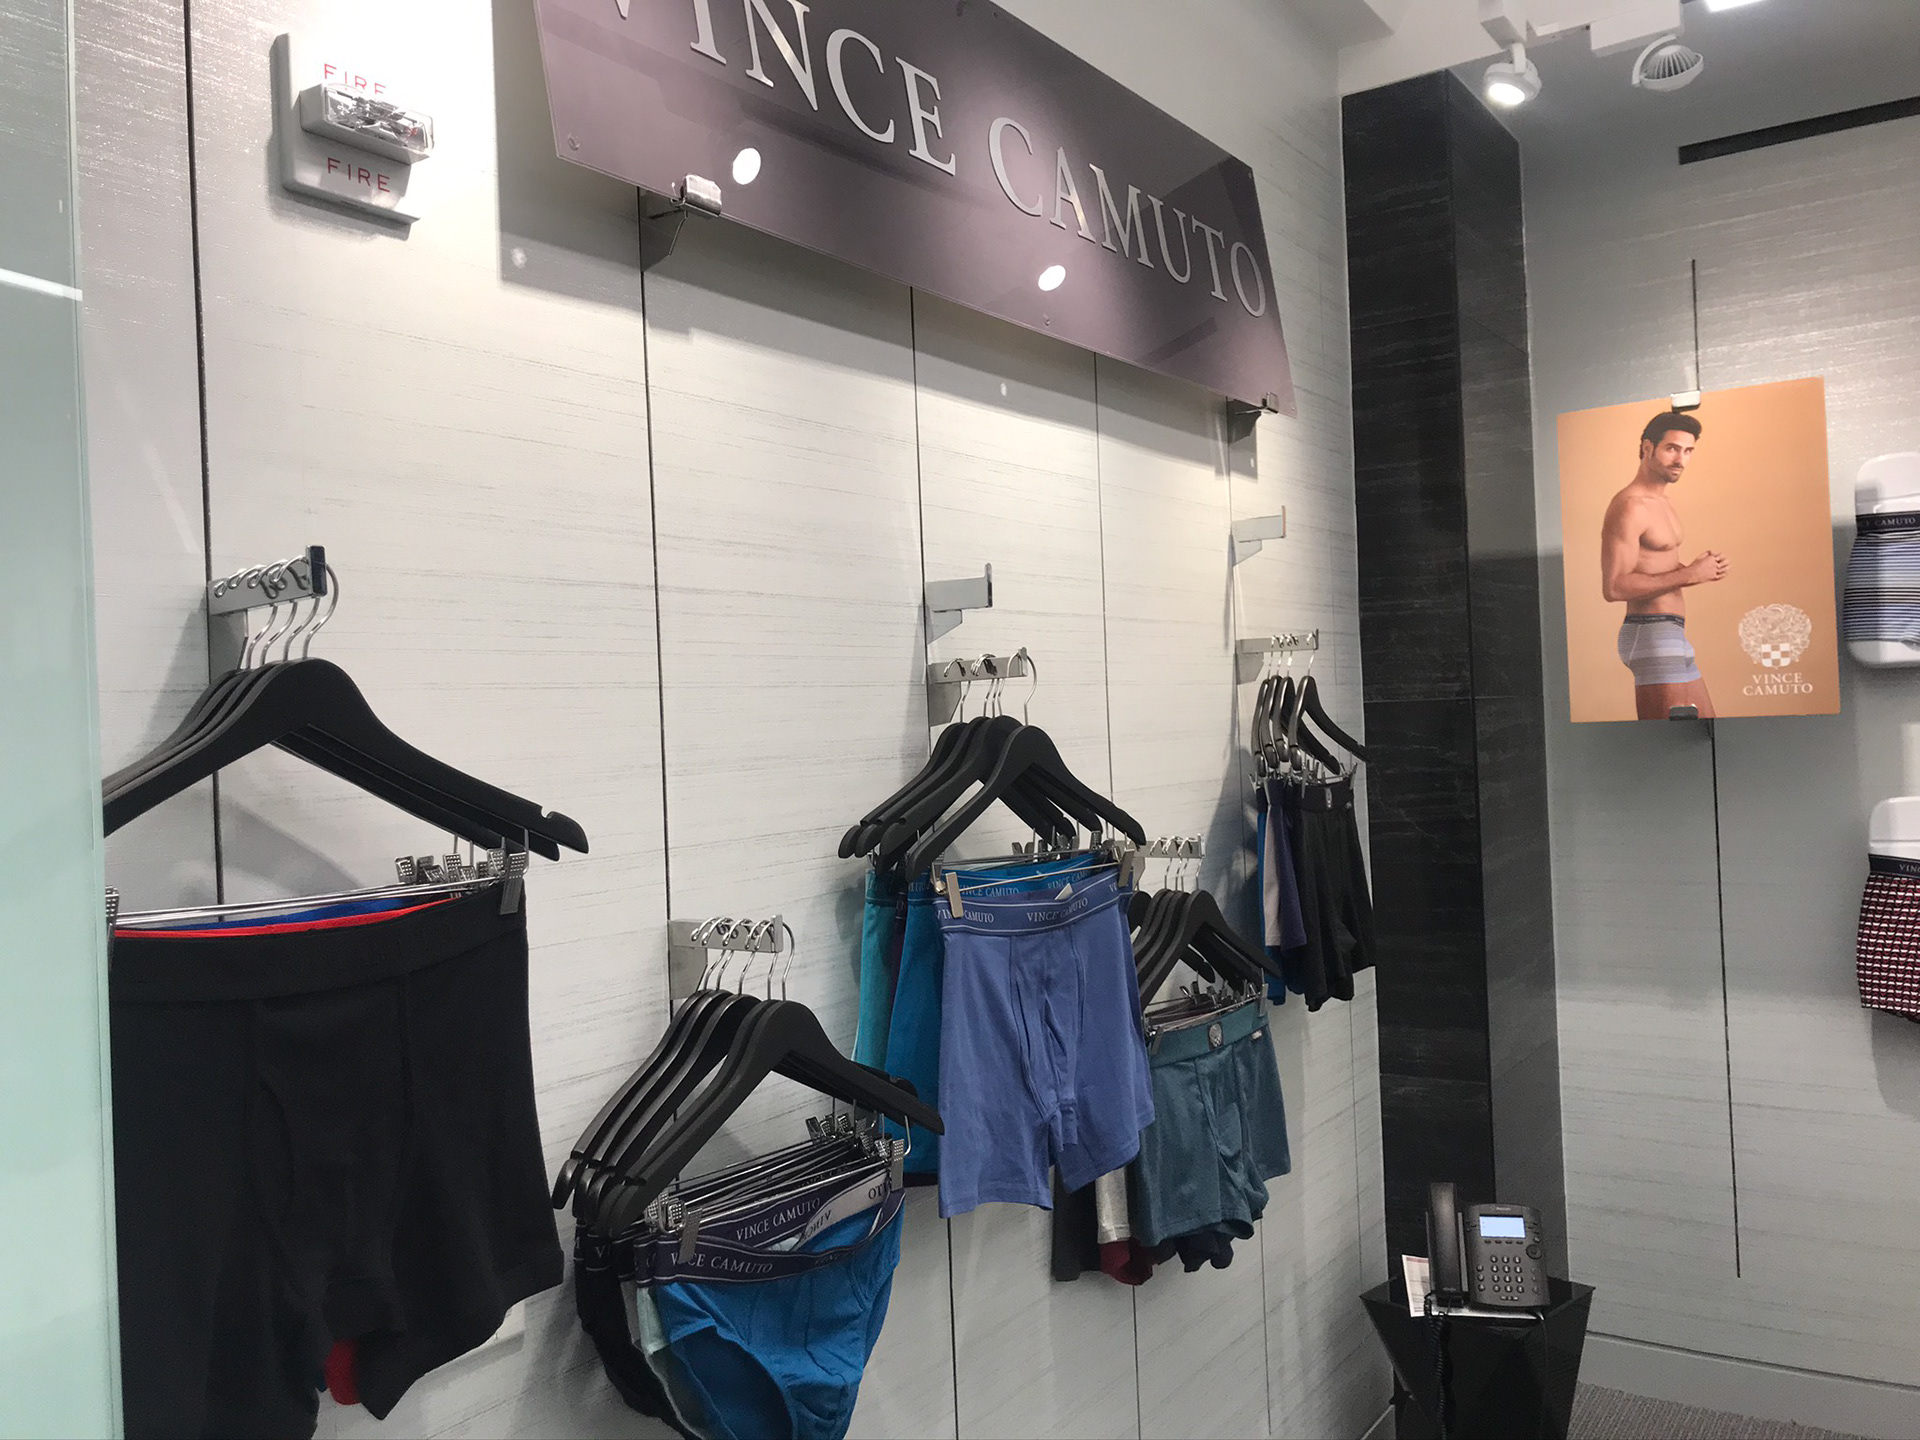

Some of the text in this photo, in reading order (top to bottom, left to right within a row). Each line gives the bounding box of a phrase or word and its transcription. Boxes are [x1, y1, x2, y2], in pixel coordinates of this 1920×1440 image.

[607, 0, 1266, 318] INCE CAMUTO
[327, 157, 391, 193] FIRE
[1752, 672, 1803, 685] VINCE
[1743, 683, 1813, 696] CAMUTO
[1026, 911, 1060, 922] VINCE
[736, 1197, 820, 1241] VINCE CAMUTO
[670, 1252, 706, 1267] VCE
[711, 1256, 773, 1273] CAMUTO
